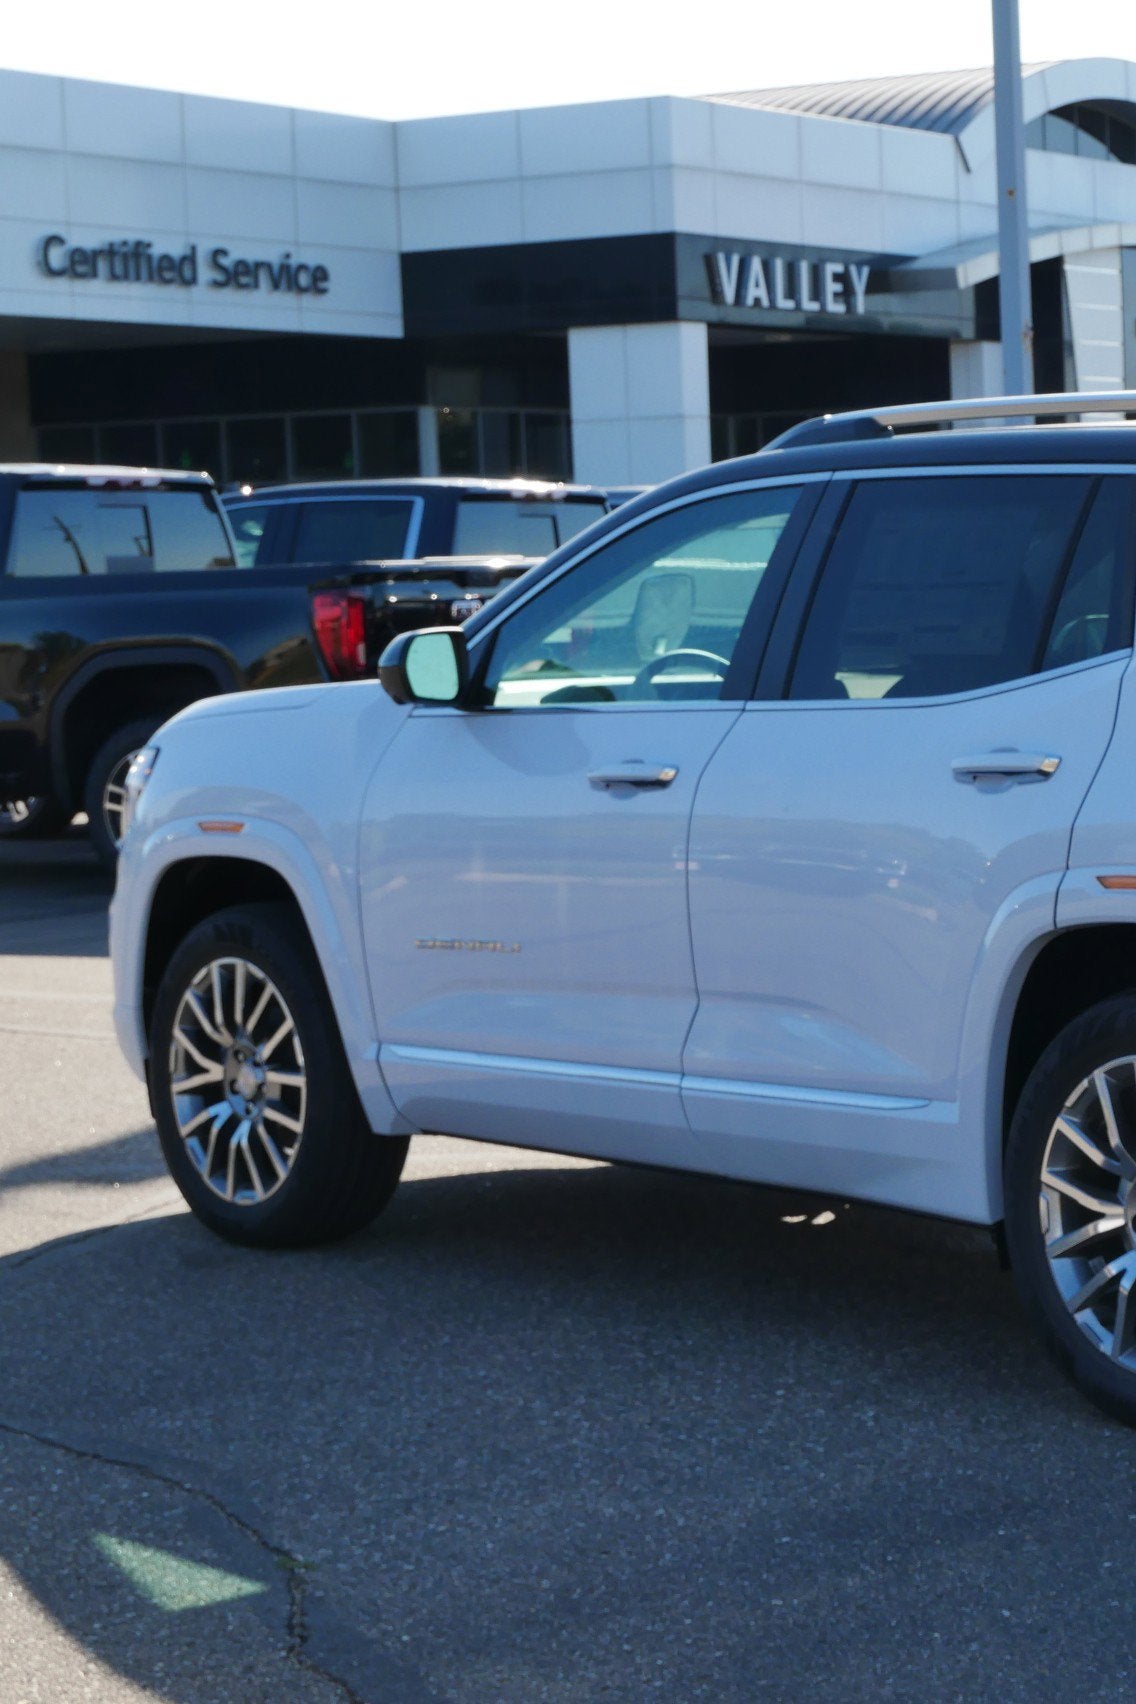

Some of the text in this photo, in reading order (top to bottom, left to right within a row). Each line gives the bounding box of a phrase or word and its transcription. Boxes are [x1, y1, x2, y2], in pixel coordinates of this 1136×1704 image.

[39, 234, 331, 295] Certified Service
[714, 252, 871, 315] VALLEY
